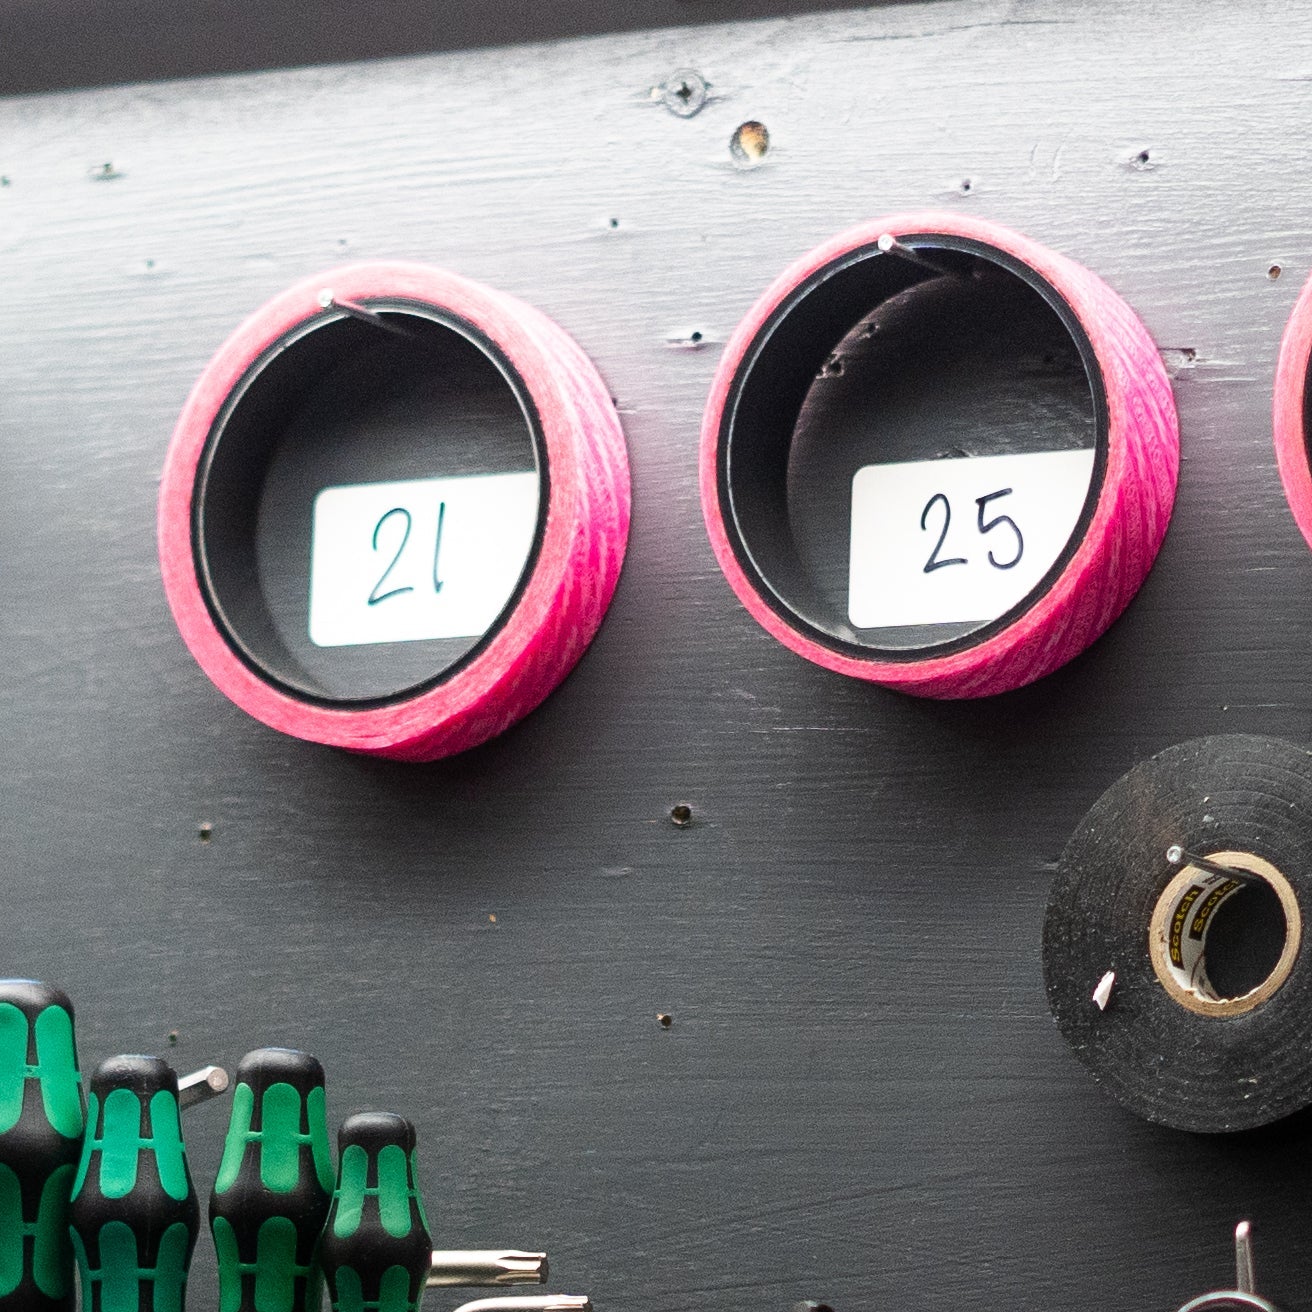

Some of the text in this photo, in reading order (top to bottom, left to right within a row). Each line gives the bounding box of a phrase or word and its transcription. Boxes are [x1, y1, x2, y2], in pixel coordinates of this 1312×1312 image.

[366, 501, 447, 606] 21
[919, 487, 1025, 574] 25
[1170, 889, 1199, 962] Scotch
